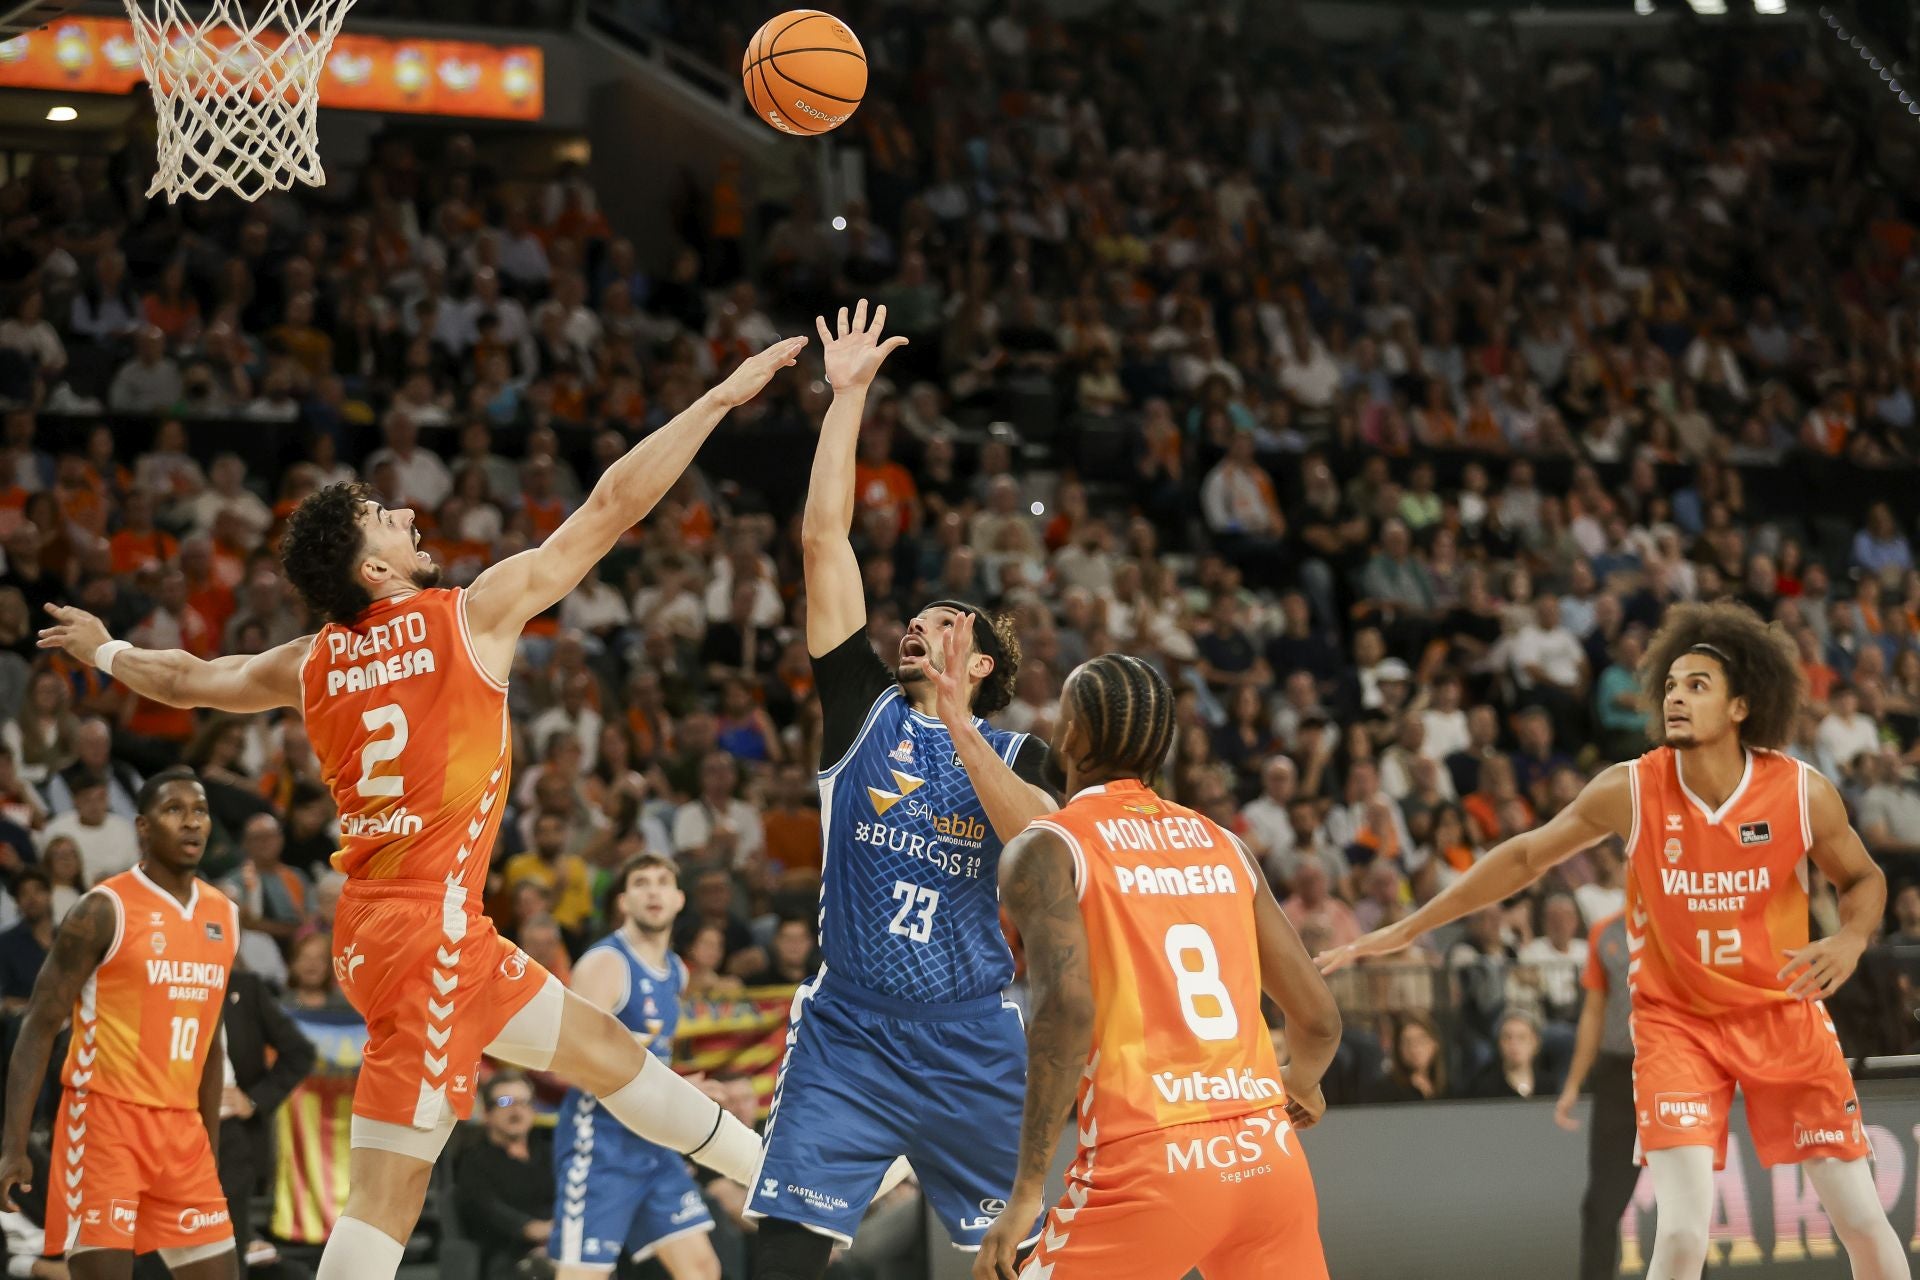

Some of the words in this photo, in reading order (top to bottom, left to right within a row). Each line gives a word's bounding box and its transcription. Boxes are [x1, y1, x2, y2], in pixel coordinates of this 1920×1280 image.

[328, 612, 427, 664] PUERTO
[327, 648, 436, 696] PAMESA
[357, 703, 409, 797] 2
[1095, 814, 1214, 851] MONTERO
[965, 867, 979, 879] 31
[967, 856, 981, 867] 20
[1114, 864, 1238, 896] PAMESA
[1660, 866, 1771, 896] VALENCIA
[888, 879, 940, 944] 23
[1687, 895, 1746, 912] BASKET
[1695, 927, 1744, 966] 12
[145, 959, 226, 990] VALENCIA
[1164, 923, 1238, 1040] 8
[167, 986, 209, 1001] BASKET
[169, 1015, 200, 1062] 10
[1165, 1130, 1263, 1175] MGS
[1797, 1127, 1845, 1146] Midea
[1220, 1163, 1272, 1183] Seguros
[787, 1184, 824, 1202] CASTILLA
